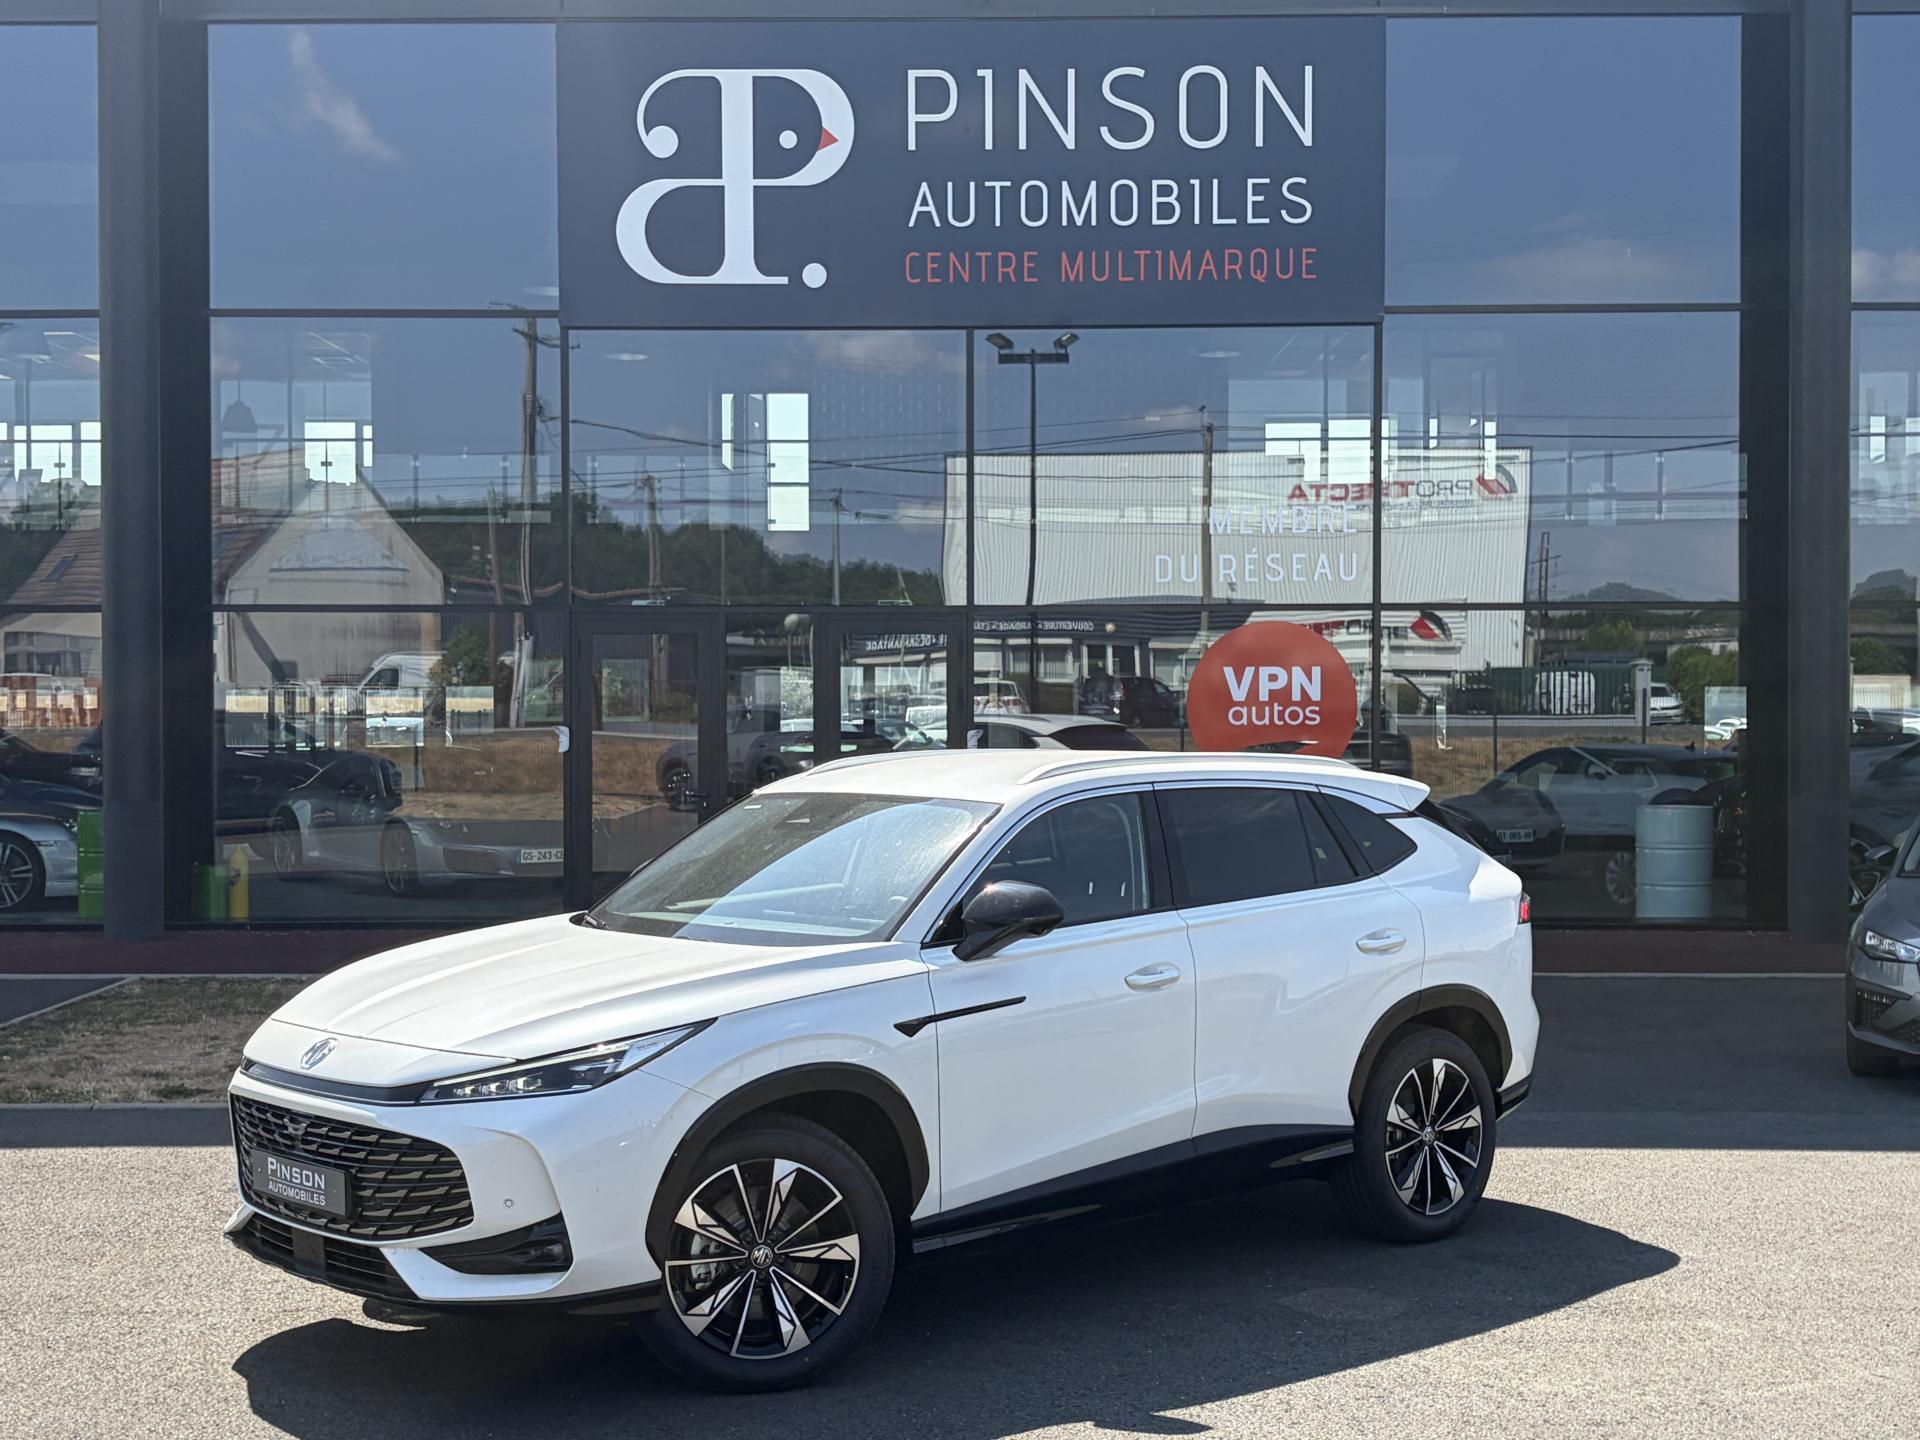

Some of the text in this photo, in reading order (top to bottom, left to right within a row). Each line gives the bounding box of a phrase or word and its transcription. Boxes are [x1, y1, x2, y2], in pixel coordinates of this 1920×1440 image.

[906, 65, 1314, 151] PINSON
[908, 177, 1312, 229] AUTOMOBILES
[905, 247, 1317, 284] CENTRE MULTIMARQUE
[1209, 503, 1358, 535] MEMBRE
[1155, 548, 1358, 583] DU RÉSEAU
[1223, 666, 1322, 702] VPN
[1228, 702, 1321, 726] autos
[267, 1156, 325, 1190] PINSON
[268, 1180, 326, 1206] AUTOMOBILES
